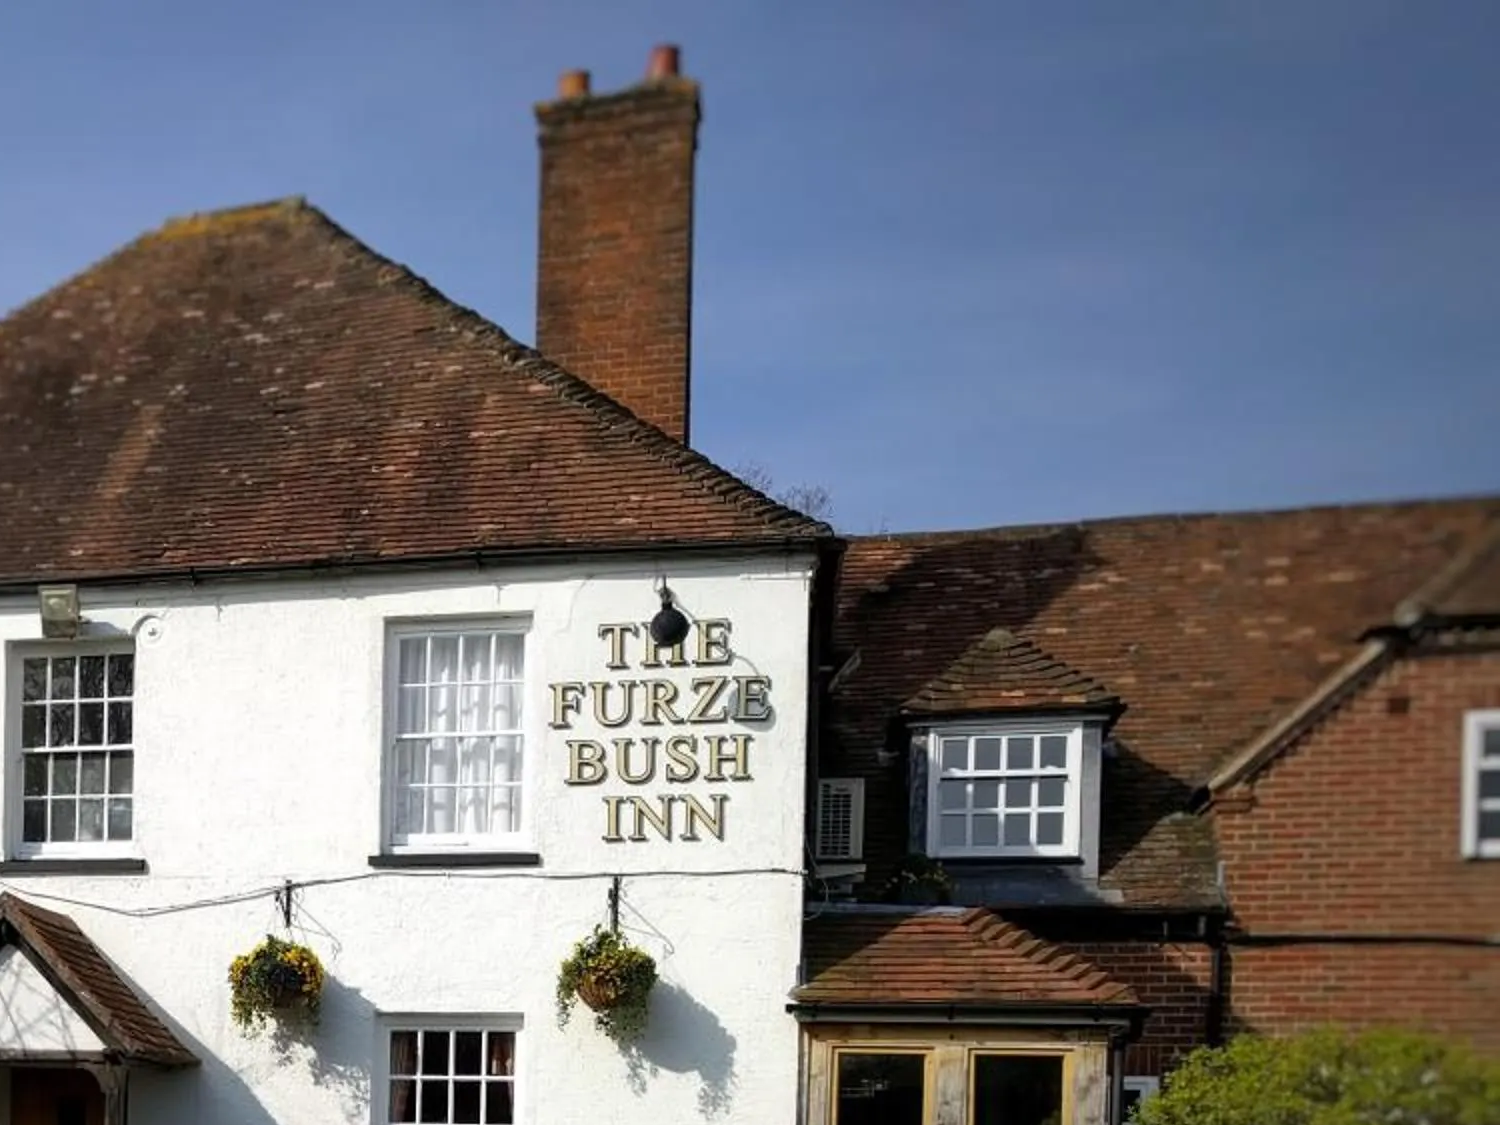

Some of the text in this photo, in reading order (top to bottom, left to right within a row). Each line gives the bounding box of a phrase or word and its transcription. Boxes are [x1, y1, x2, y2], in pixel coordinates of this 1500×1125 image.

[549, 675, 773, 729] FURZE
[565, 734, 754, 786] BUSH
[602, 794, 729, 843] INN
